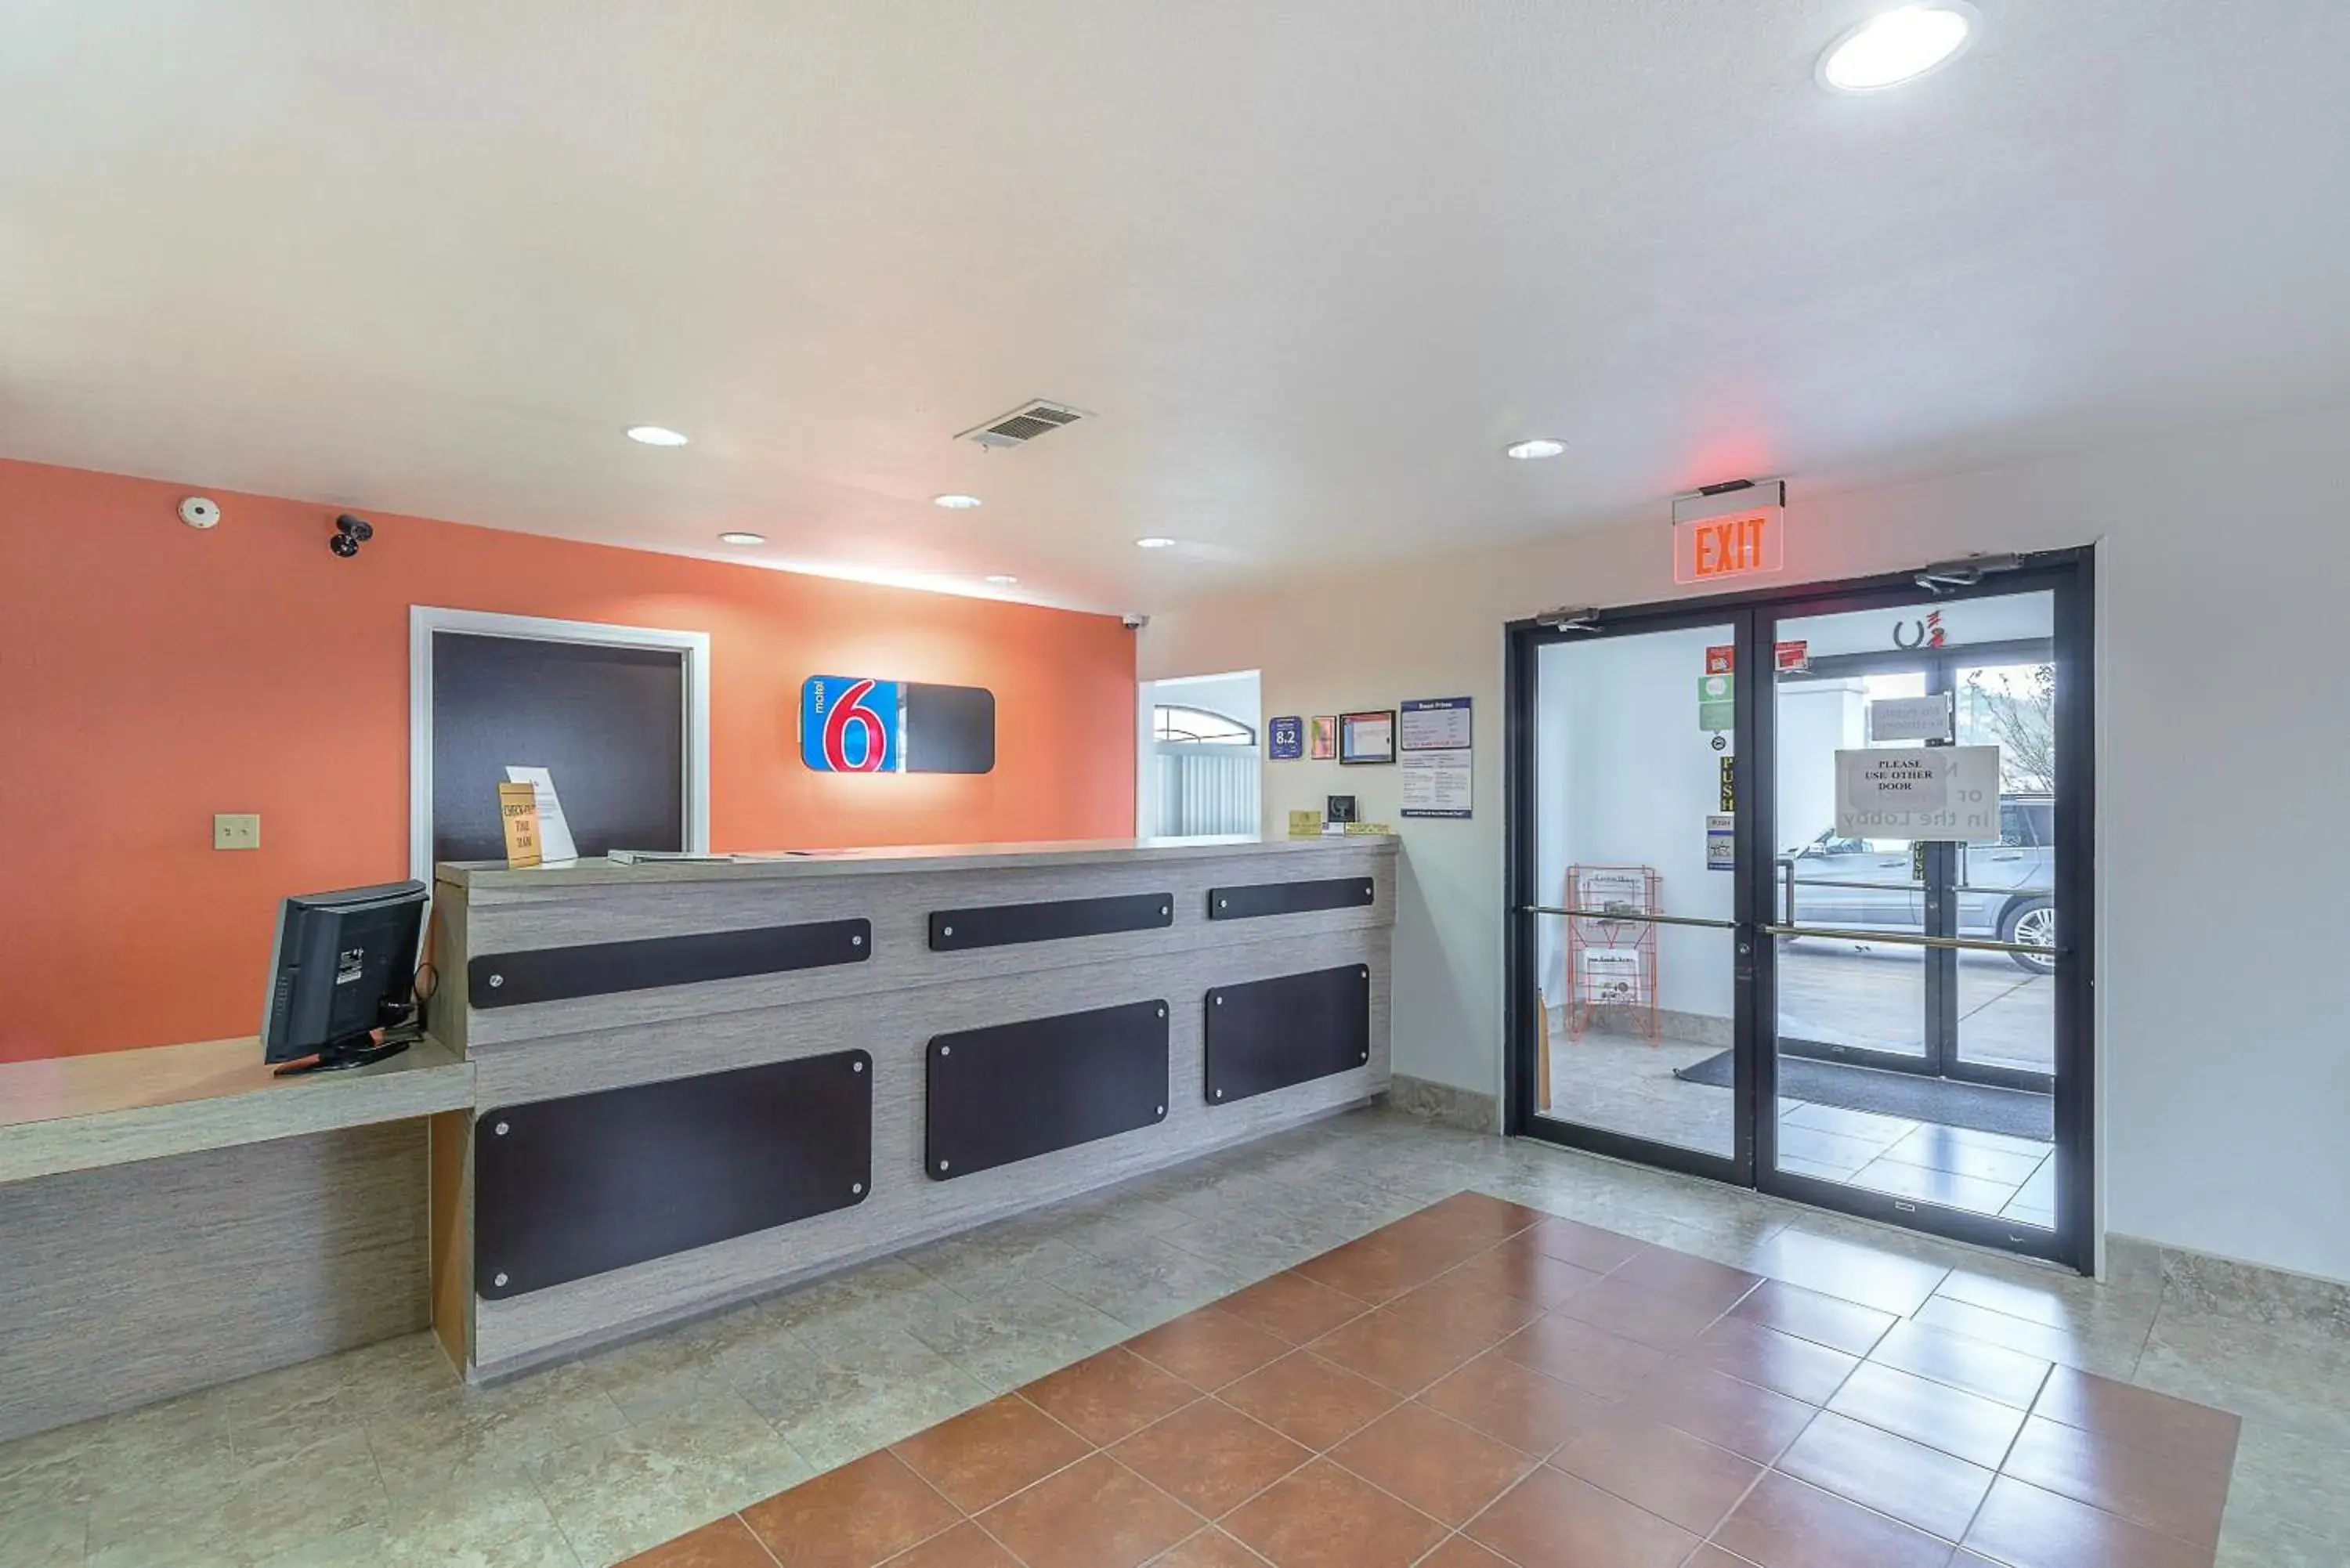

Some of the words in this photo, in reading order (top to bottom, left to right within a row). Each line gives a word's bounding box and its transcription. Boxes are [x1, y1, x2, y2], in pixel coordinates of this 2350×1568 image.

[1695, 516, 1765, 576] EXIT
[814, 681, 823, 714] motel
[822, 679, 886, 772] 6
[1276, 730, 1295, 744] 8.2
[1865, 771, 1886, 779] USE
[1891, 770, 1933, 779] OTHER
[1878, 760, 1922, 768] PLEASE
[1723, 757, 1734, 810] PUSH
